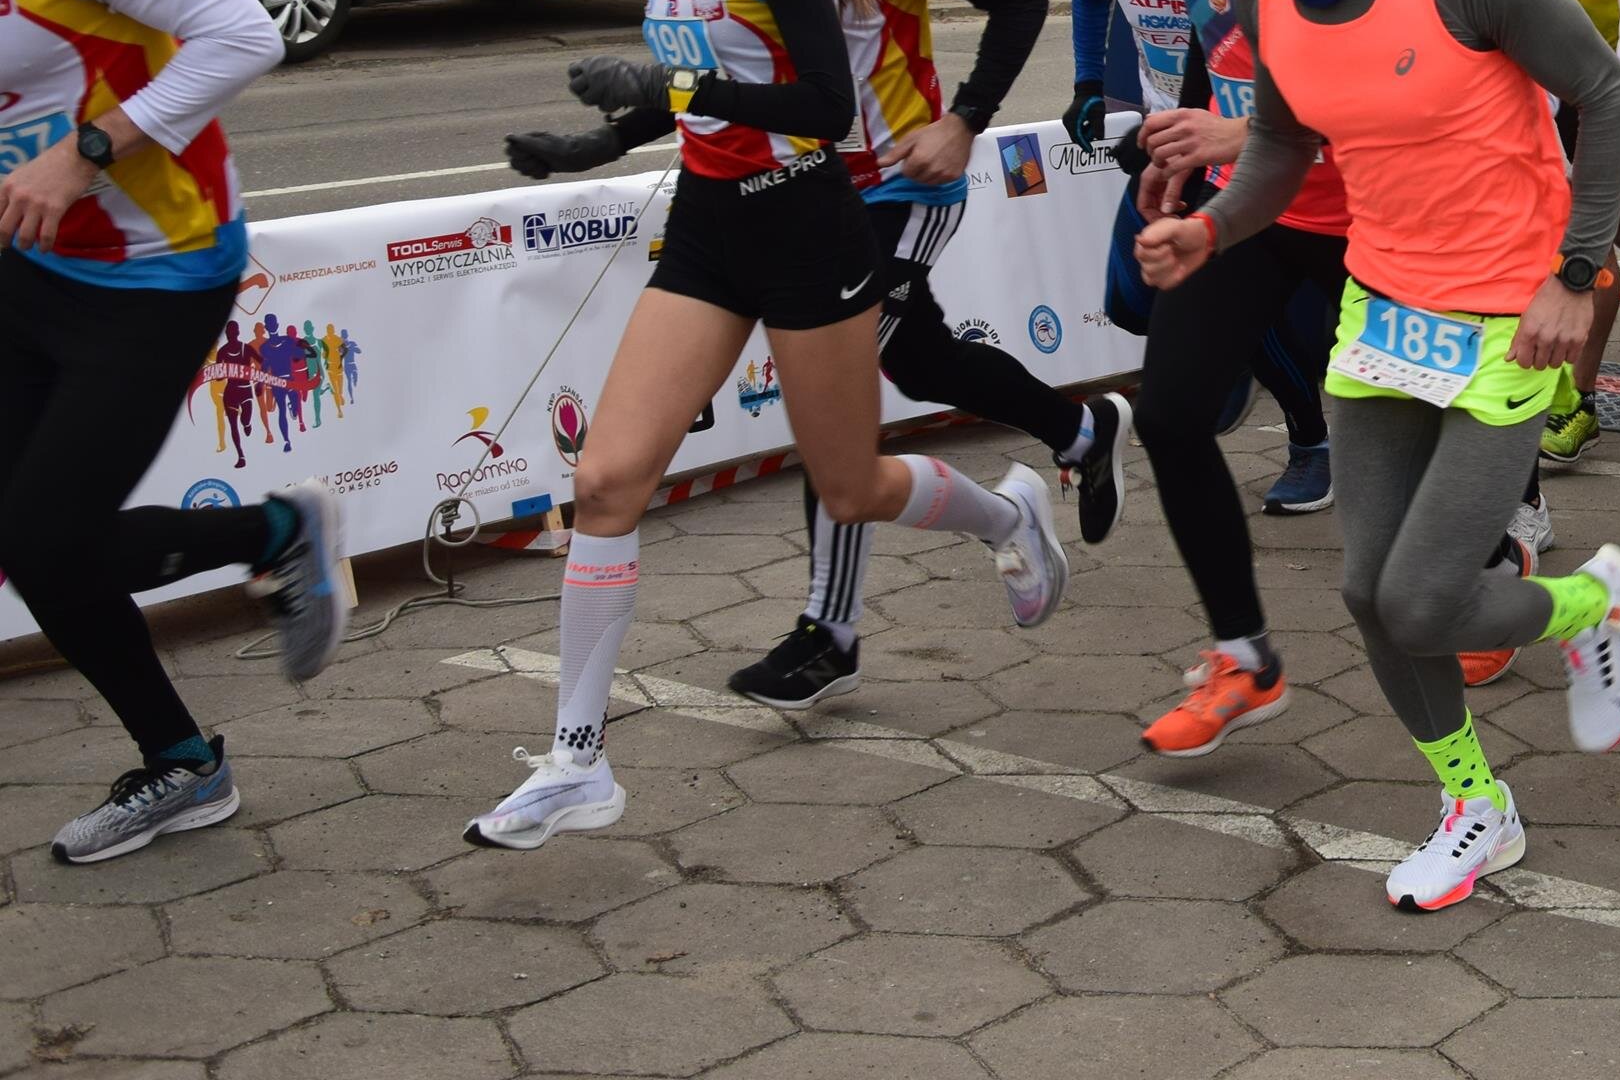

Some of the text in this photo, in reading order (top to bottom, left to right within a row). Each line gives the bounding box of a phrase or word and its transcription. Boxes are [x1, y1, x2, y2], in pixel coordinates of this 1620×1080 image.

[648, 23, 702, 65] 190
[739, 168, 786, 196] NIKE
[789, 149, 827, 178] PRO
[558, 201, 635, 220] PRODUCENT
[560, 216, 638, 244] KOBUD
[279, 260, 377, 283] NARZĘDZIA-SUPLICKI
[390, 247, 515, 278] WYPOŻYCZALNIA
[433, 270, 454, 283] SERWIS
[973, 318, 990, 331] LIFE
[1380, 306, 1462, 369] 185
[203, 362, 229, 382] SZANSA
[229, 364, 239, 379] NA
[250, 367, 287, 388] RADOMSKO
[335, 461, 399, 486] JOGGING
[436, 458, 528, 493] Radomsko
[475, 485, 498, 497] miasto
[500, 480, 511, 491] od
[512, 477, 530, 489] 1266
